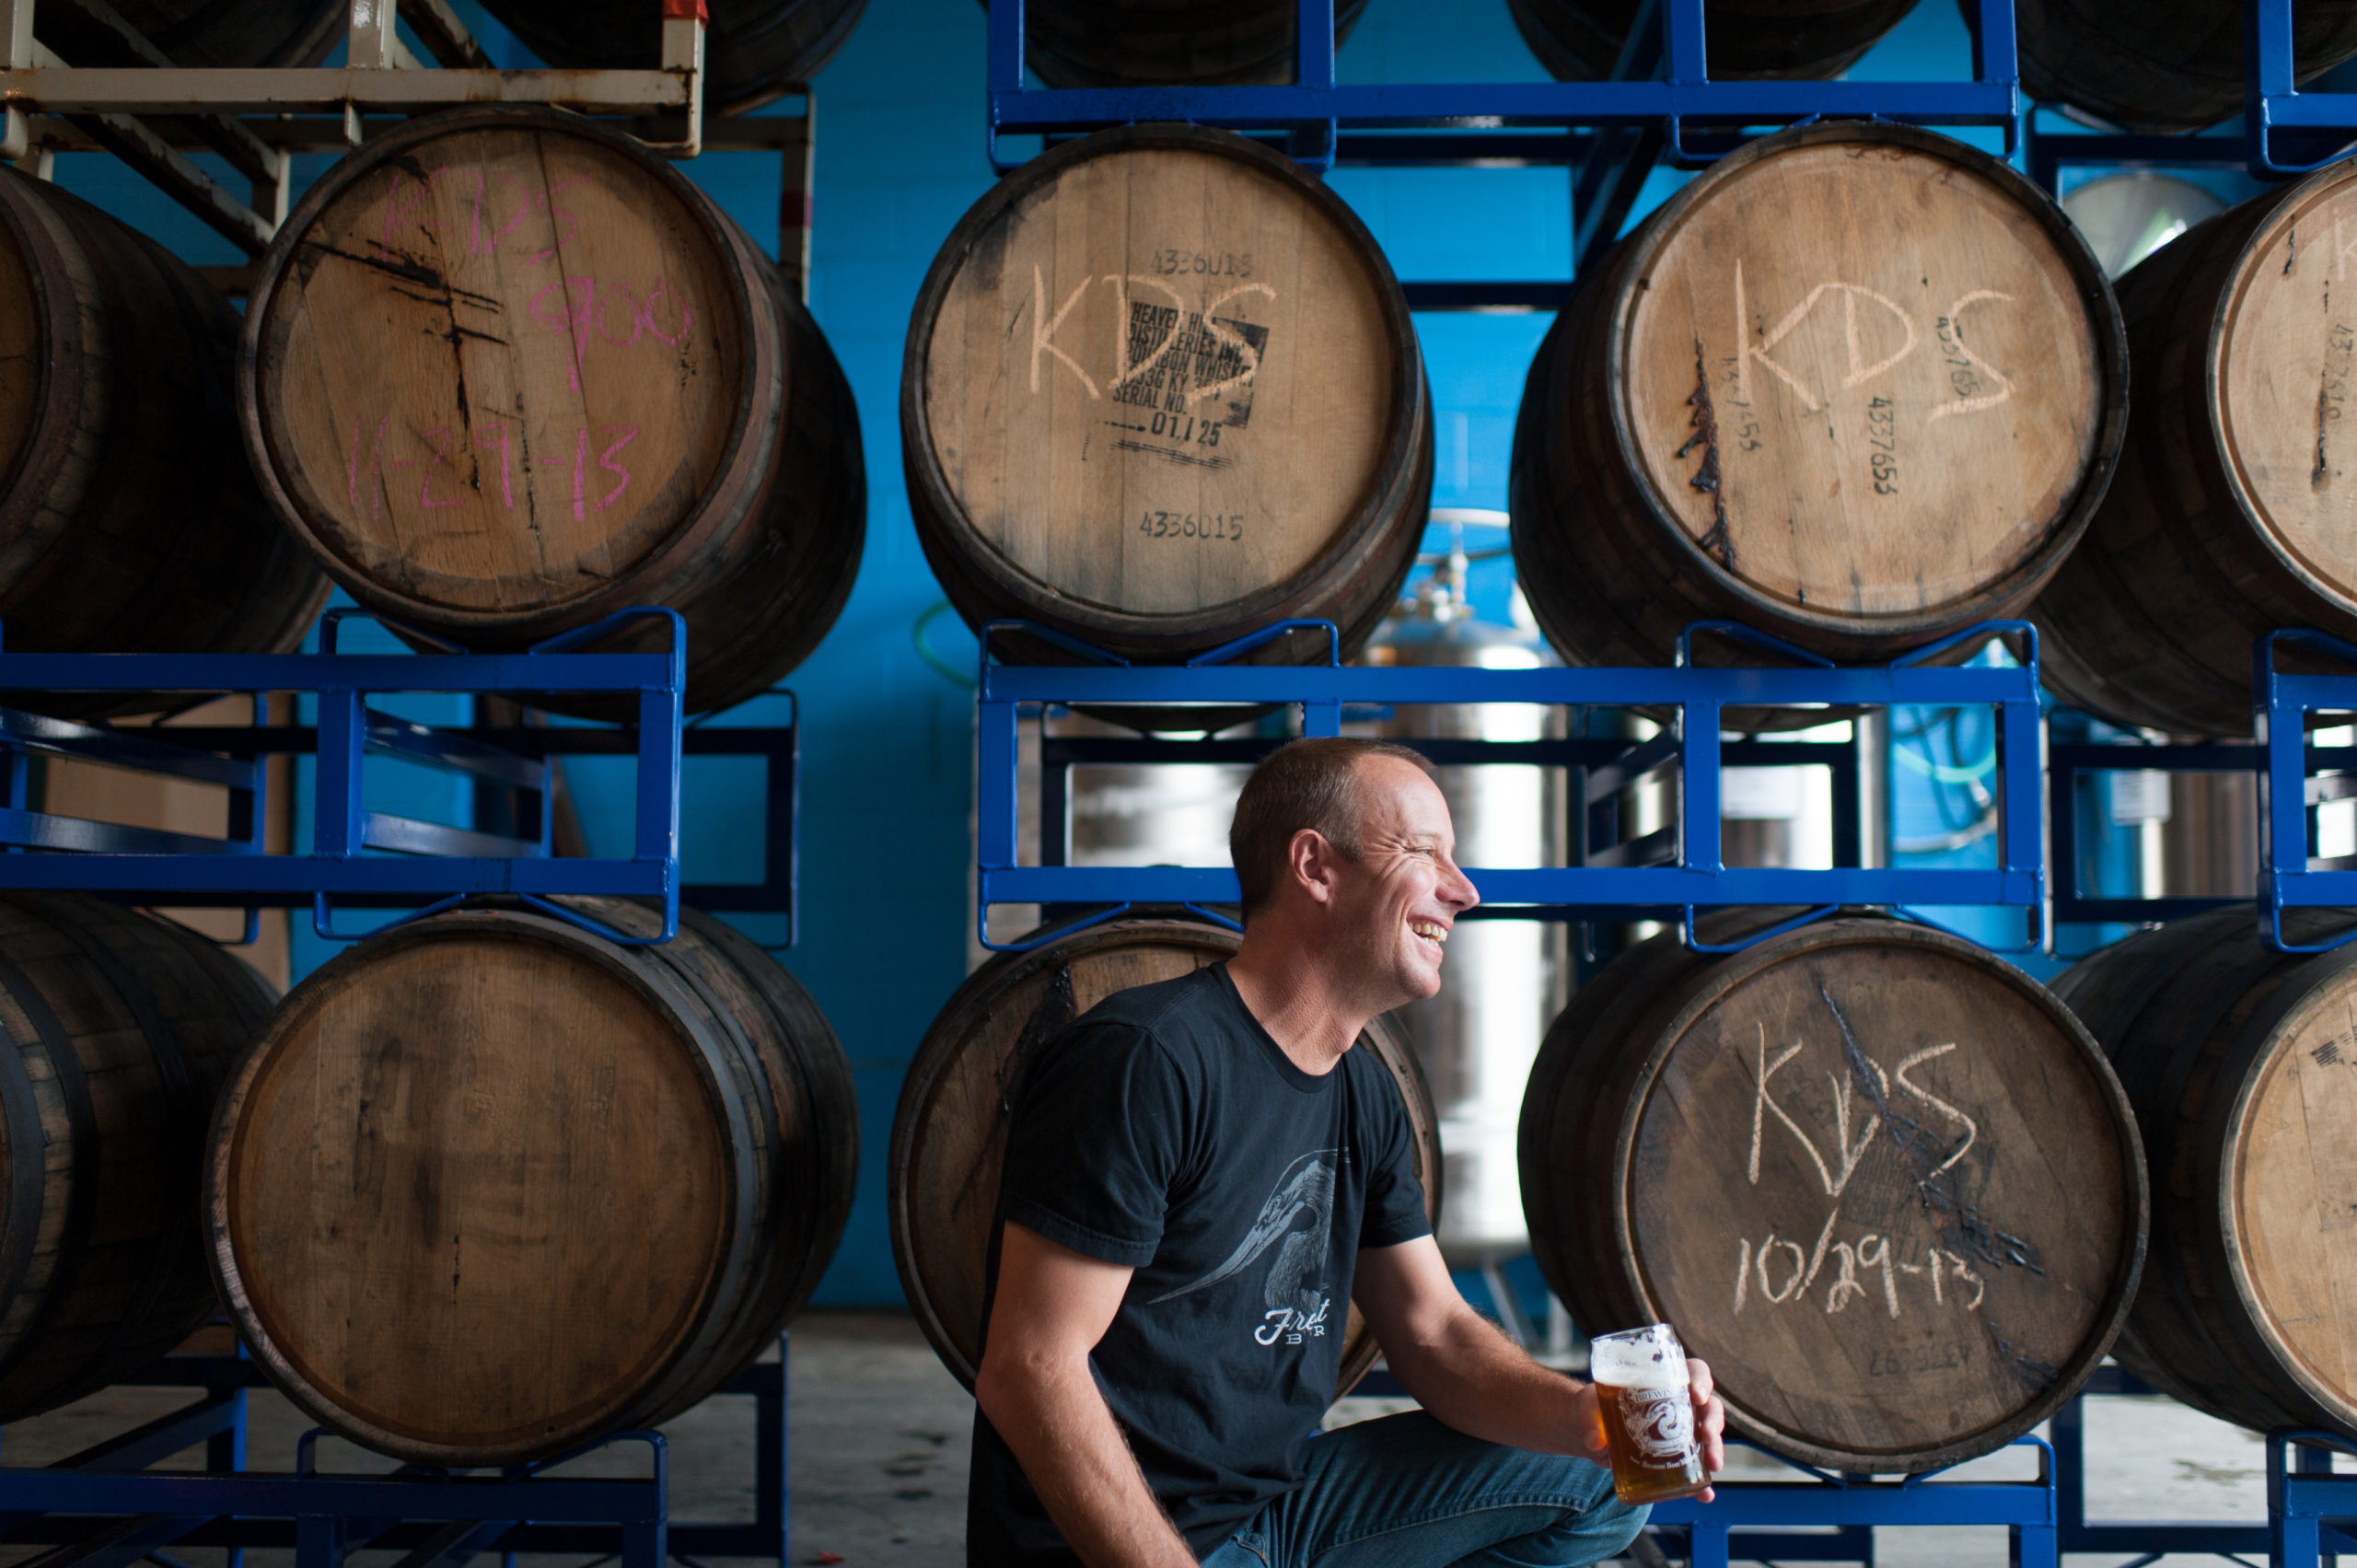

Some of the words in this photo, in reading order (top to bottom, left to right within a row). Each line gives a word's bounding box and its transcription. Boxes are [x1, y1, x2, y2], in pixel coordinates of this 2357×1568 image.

[1031, 264, 1276, 406] KDS
[1736, 258, 2016, 423] KDS
[1113, 386, 1158, 409] SERIAL
[1164, 394, 1188, 414] NO.
[350, 415, 639, 522] 11-29-13
[1139, 511, 1245, 541] 4336015
[1734, 1207, 1983, 1319] 10/29-13
